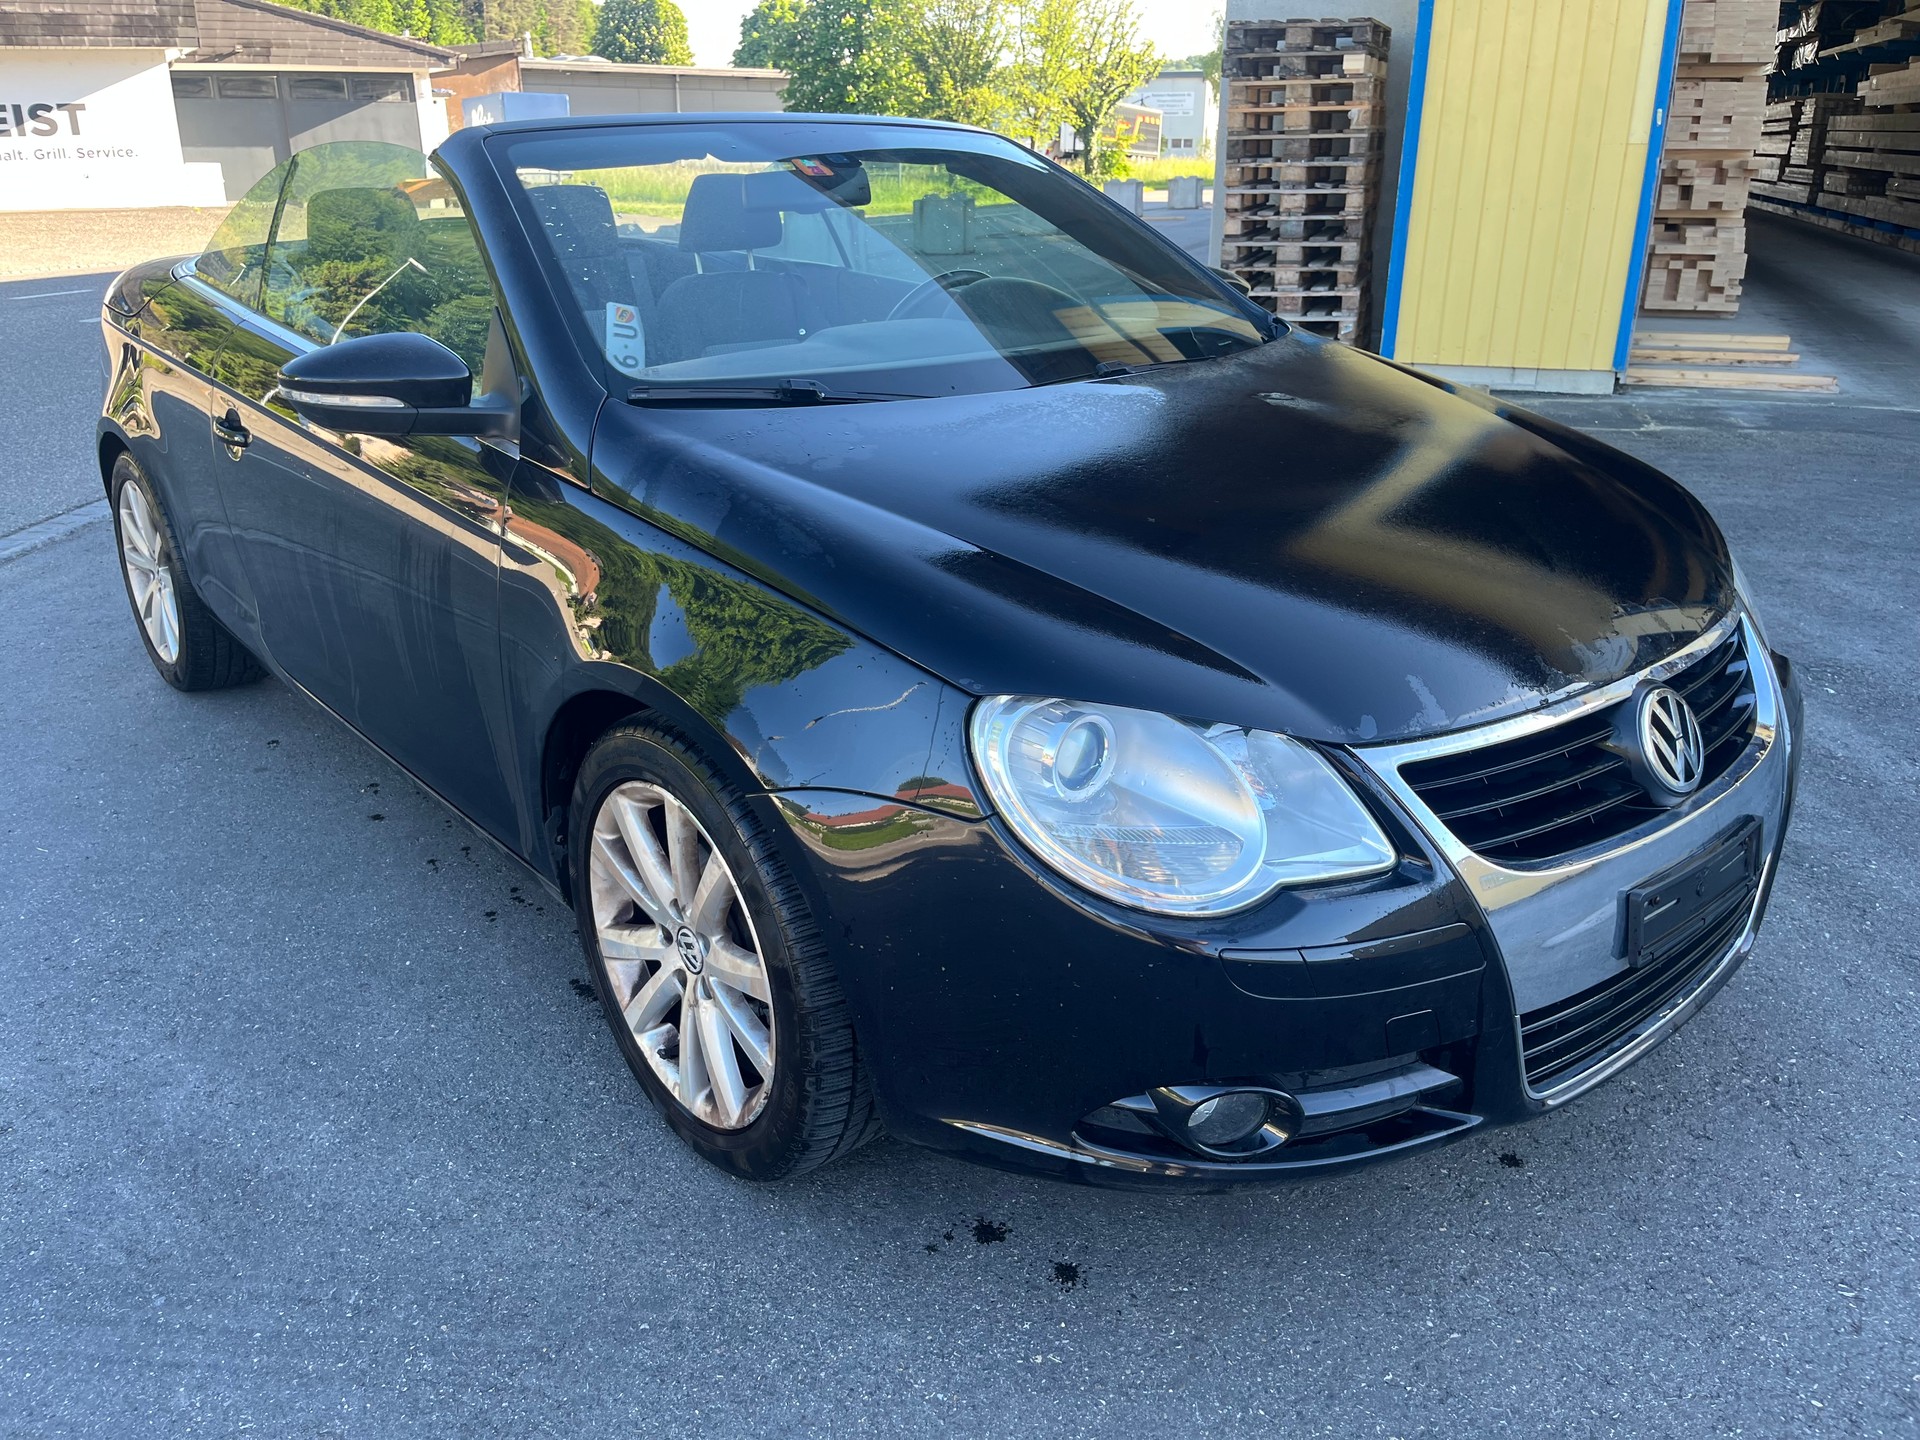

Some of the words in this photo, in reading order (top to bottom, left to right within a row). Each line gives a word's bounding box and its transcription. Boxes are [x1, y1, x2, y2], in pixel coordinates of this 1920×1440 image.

[0, 149, 28, 161] alt.
[34, 148, 71, 160] Grill.
[76, 146, 139, 159] Service.
